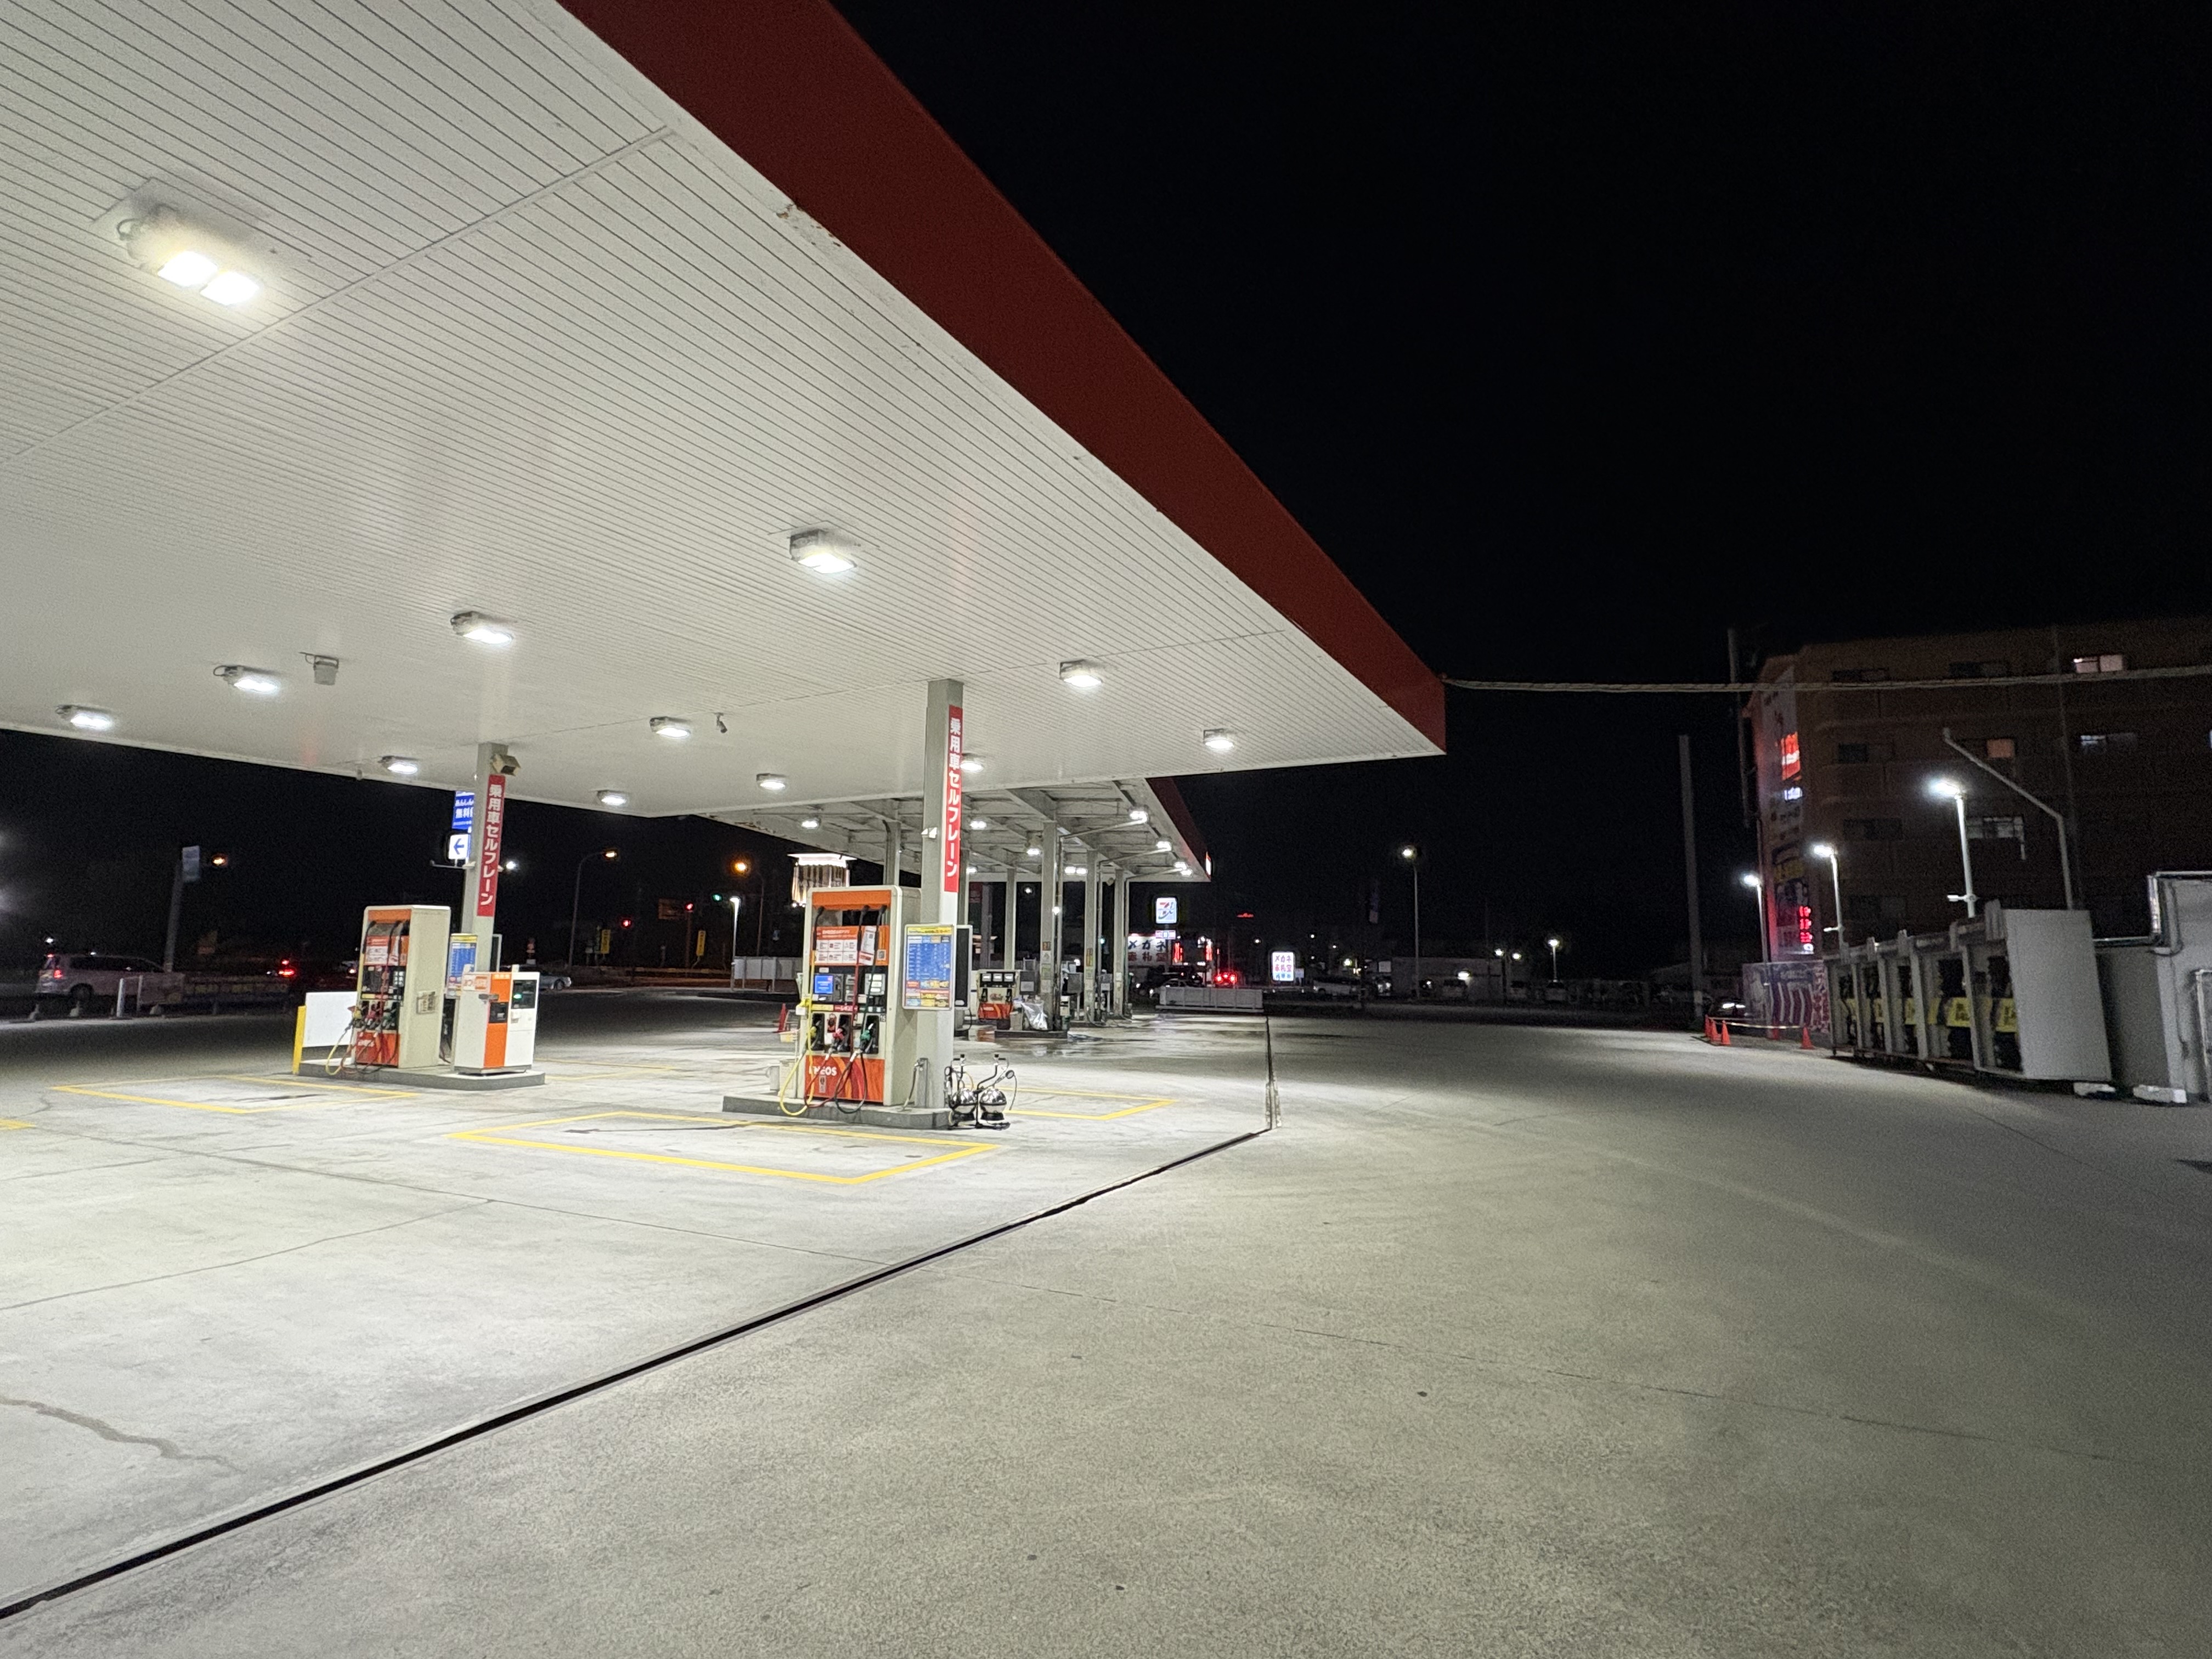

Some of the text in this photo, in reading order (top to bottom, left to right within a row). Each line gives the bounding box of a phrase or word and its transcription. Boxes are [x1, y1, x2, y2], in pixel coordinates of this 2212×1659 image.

[947, 717, 961, 877] 乗用車セルフレーン
[480, 784, 503, 905] 乗用車セルフレーン
[1128, 940, 1166, 952] メガネ
[1275, 955, 1292, 963] メガネ
